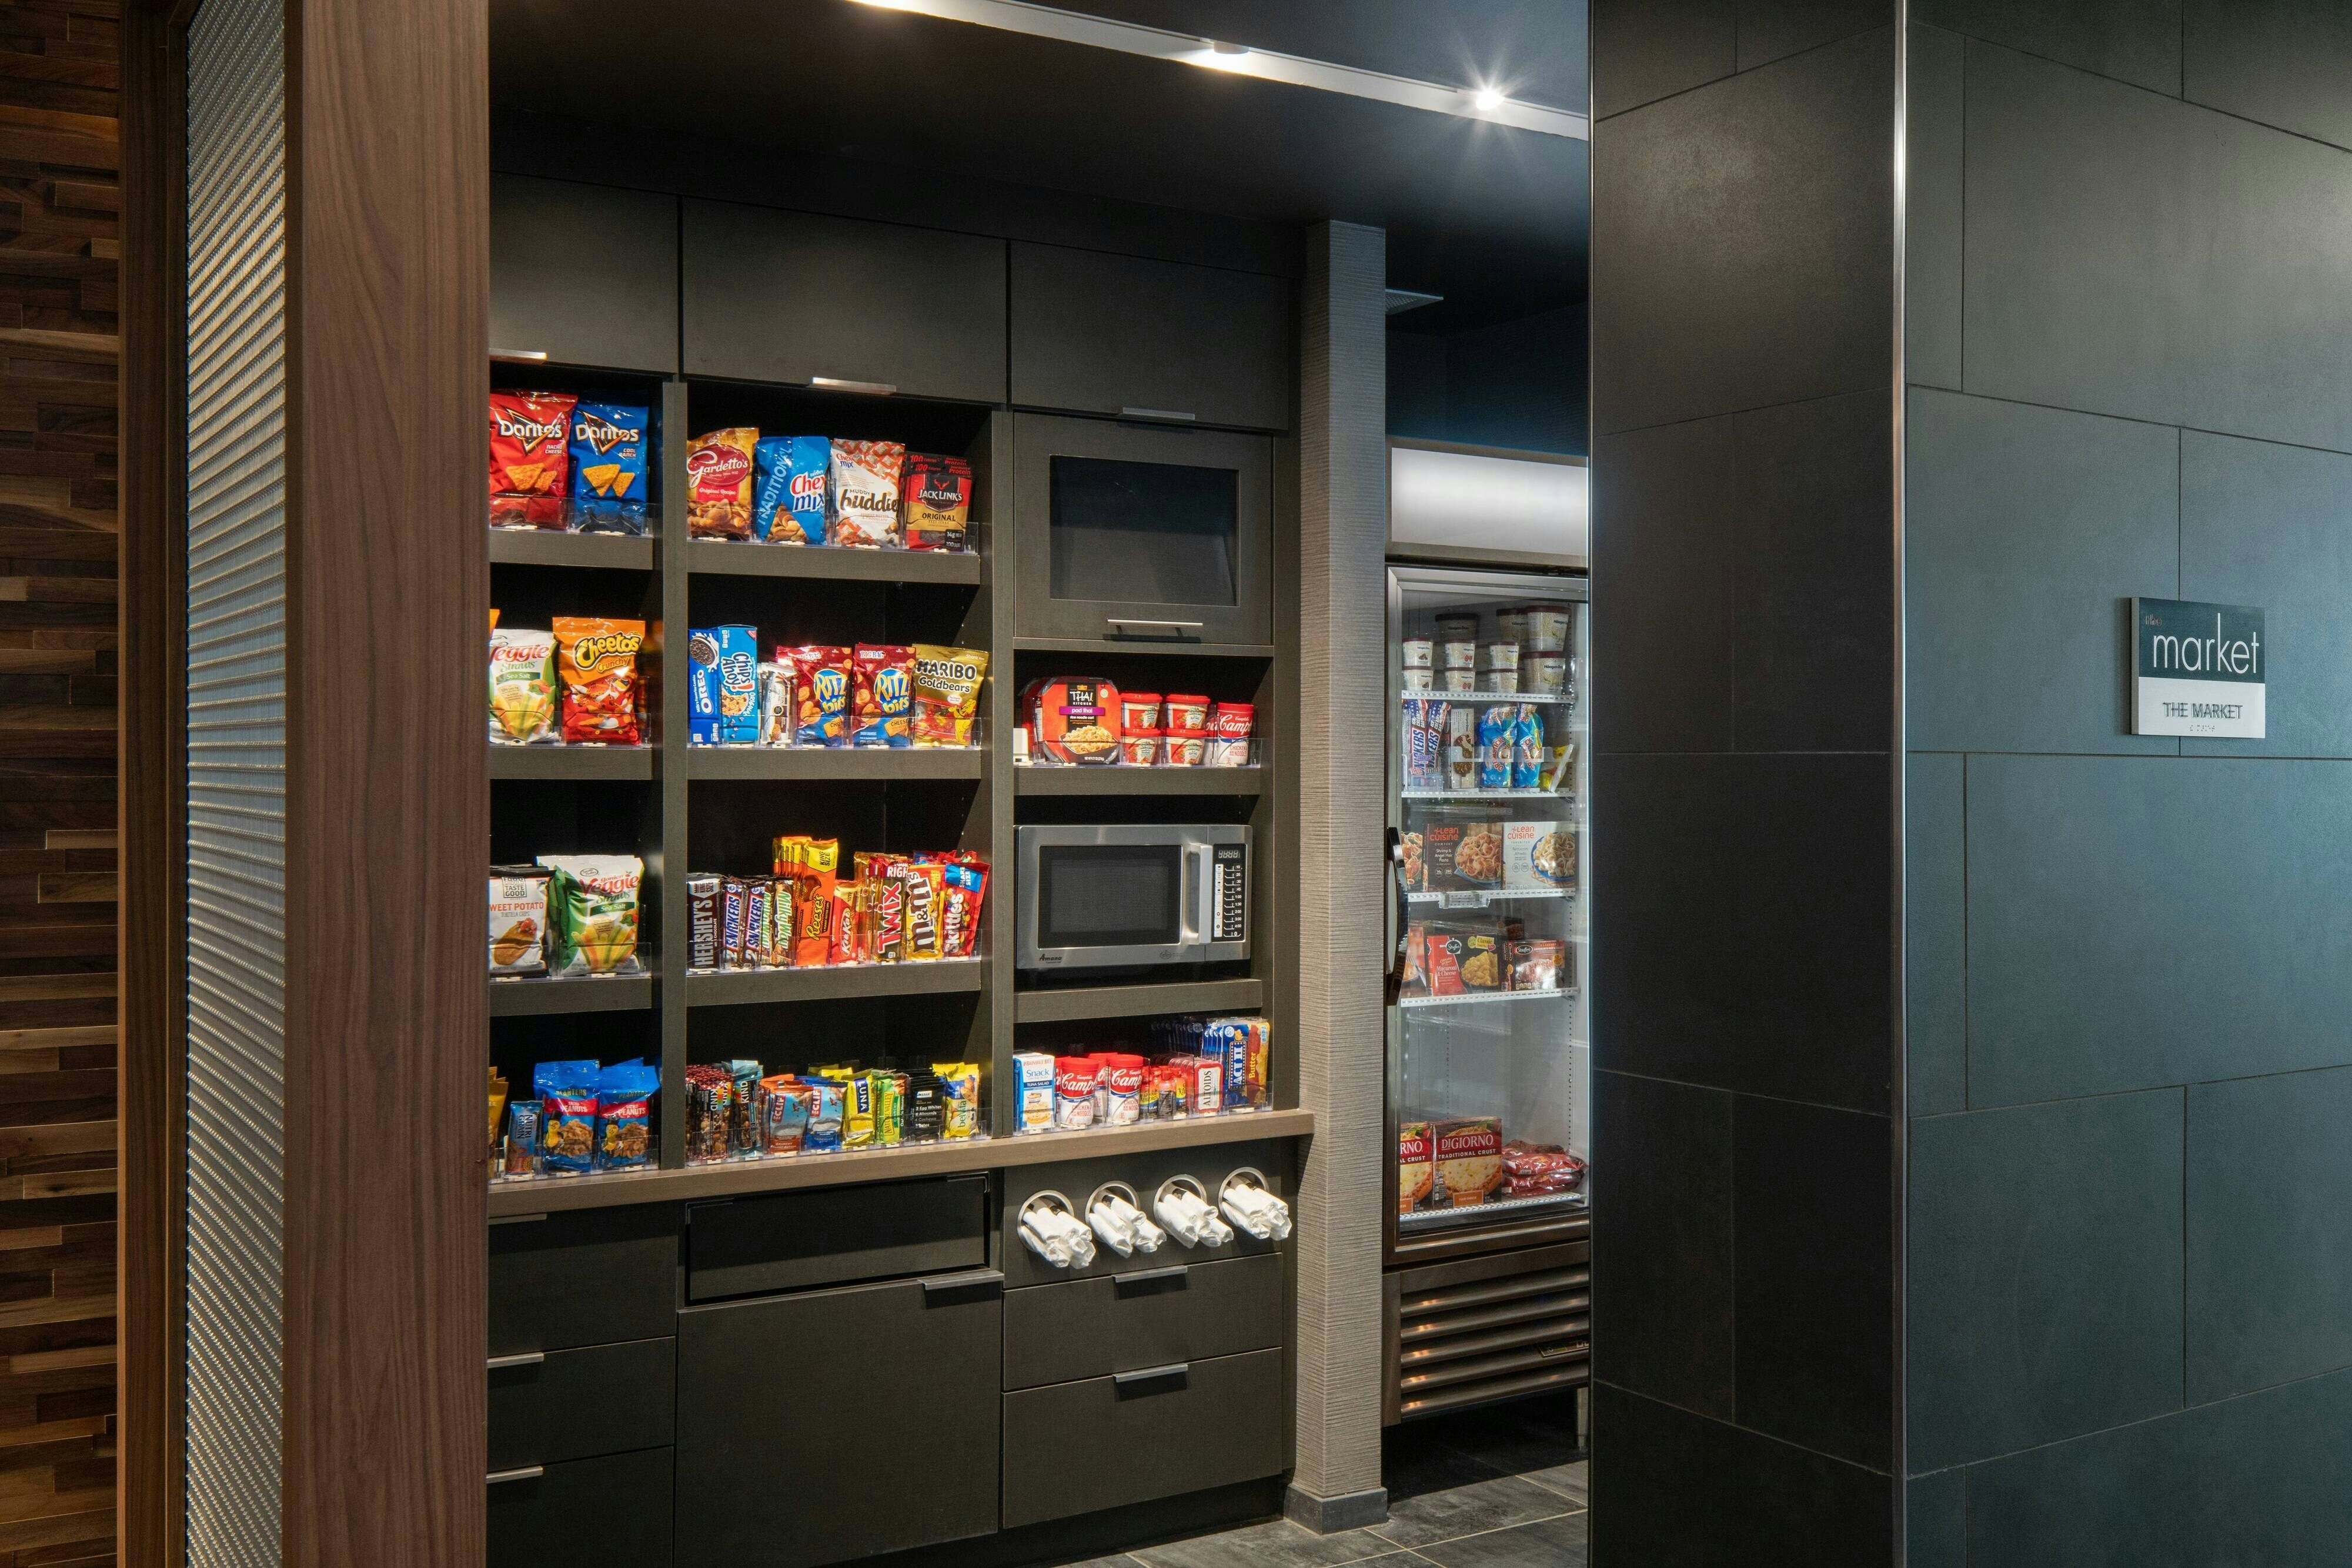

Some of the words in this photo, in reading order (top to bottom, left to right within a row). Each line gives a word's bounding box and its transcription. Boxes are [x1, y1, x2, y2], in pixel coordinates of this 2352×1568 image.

[500, 420, 563, 438] Doritos
[575, 424, 640, 442] Doritos
[687, 450, 748, 489] Gardetto's
[790, 473, 825, 496] Chex
[918, 489, 938, 500] JACK
[794, 493, 825, 511] mix
[840, 489, 898, 513] buddie
[922, 513, 956, 521] ORIGINAL
[2145, 614, 2161, 626] the
[575, 633, 640, 668] Cheetos
[860, 650, 871, 658] BIG
[2153, 613, 2259, 674] market
[596, 657, 629, 673] Crunchy
[916, 659, 976, 680] HARIBO
[697, 669, 713, 714] OREO
[814, 674, 848, 700] RITZ
[876, 674, 910, 701] RITZ
[918, 677, 971, 693] Goldbears
[822, 696, 846, 714] bits
[882, 696, 910, 714] bits
[1070, 691, 1093, 701] THAI
[2162, 702, 2189, 717] THE
[2191, 703, 2243, 719] MARKET
[887, 867, 908, 878] RIGH
[579, 872, 640, 896] Veggie
[489, 903, 512, 912] WEET
[514, 902, 544, 910] POTATO
[774, 891, 792, 923] Milky
[806, 894, 824, 941] Reese's
[878, 882, 901, 953] TWIX
[725, 896, 741, 948] SNICKERS
[746, 897, 763, 948] SNICKERS
[693, 900, 714, 966] HERSHEY'S
[776, 924, 792, 949] Way
[1233, 1046, 1243, 1061] II
[1026, 1069, 1050, 1077] Snack
[1233, 1061, 1243, 1085] ACT
[1248, 1052, 1257, 1079] Butter
[555, 1089, 587, 1097] PLANTERS
[741, 1081, 749, 1104] KIND
[857, 1081, 868, 1111] LUNA
[1202, 1069, 1212, 1106] ALTOIDS
[560, 1105, 588, 1113] PEANUTS
[619, 1107, 646, 1115] PEANUTS
[884, 1092, 893, 1113] VALLEY
[884, 1113, 893, 1134] NATURE
[958, 1100, 967, 1128] belVita
[525, 1114, 533, 1139] NUTRI
[1441, 1134, 1494, 1150] DIGIORNO
[1438, 1151, 1476, 1159] TRADITIONAL
